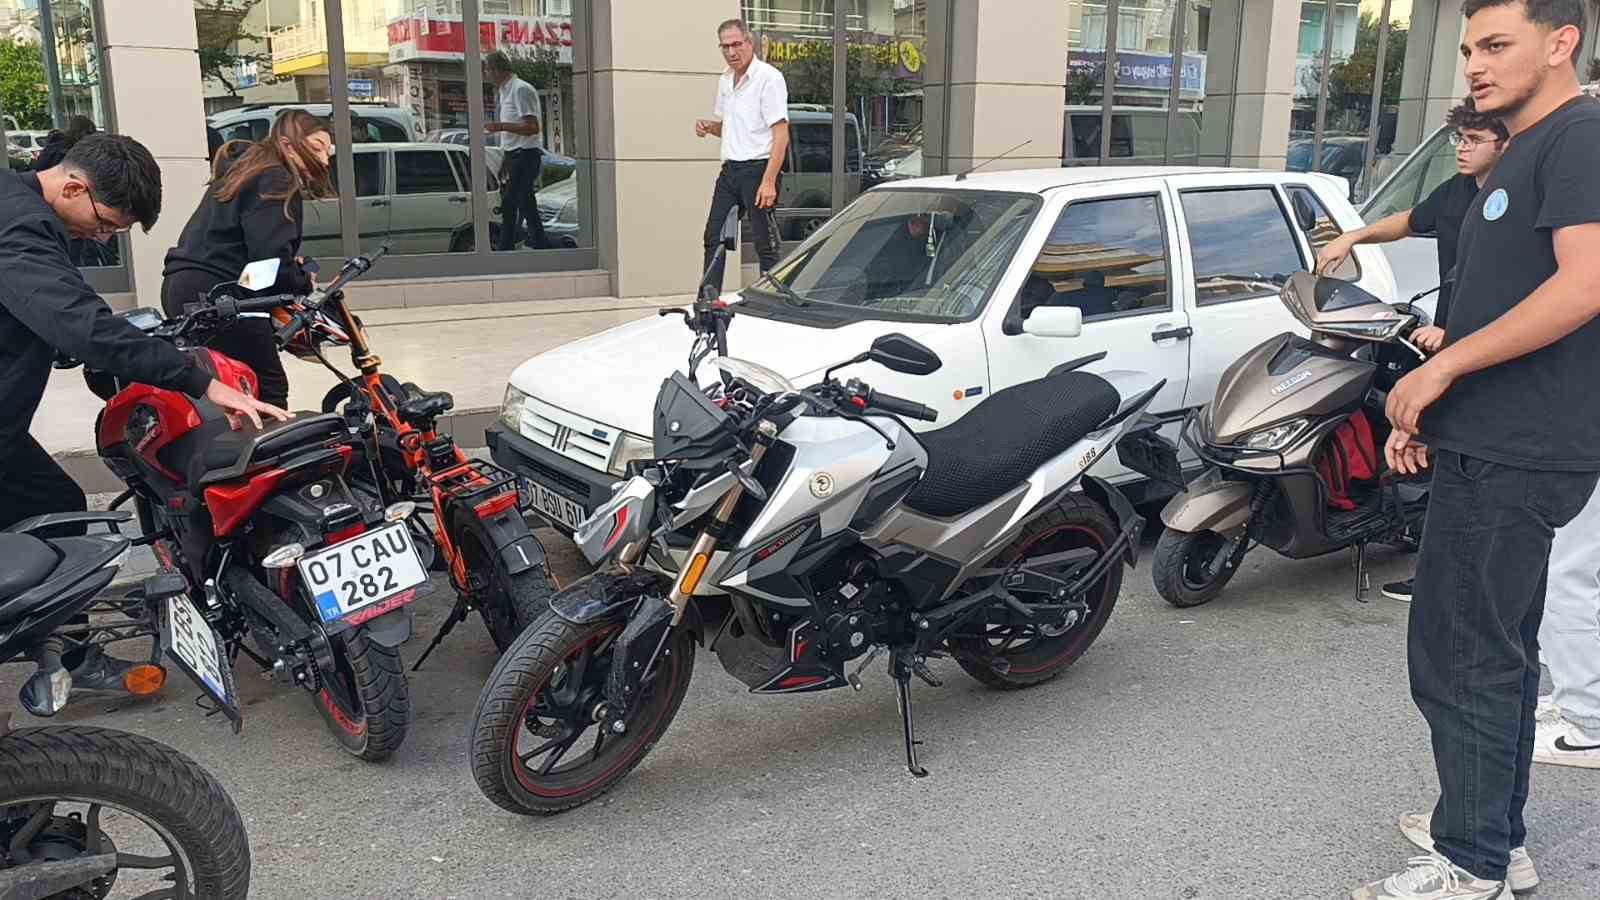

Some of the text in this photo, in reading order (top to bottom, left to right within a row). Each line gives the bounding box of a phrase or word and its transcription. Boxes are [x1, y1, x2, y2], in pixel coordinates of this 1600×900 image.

[308, 529, 408, 585] 07 CAU
[341, 566, 398, 606] 282
[326, 606, 339, 617] TR
